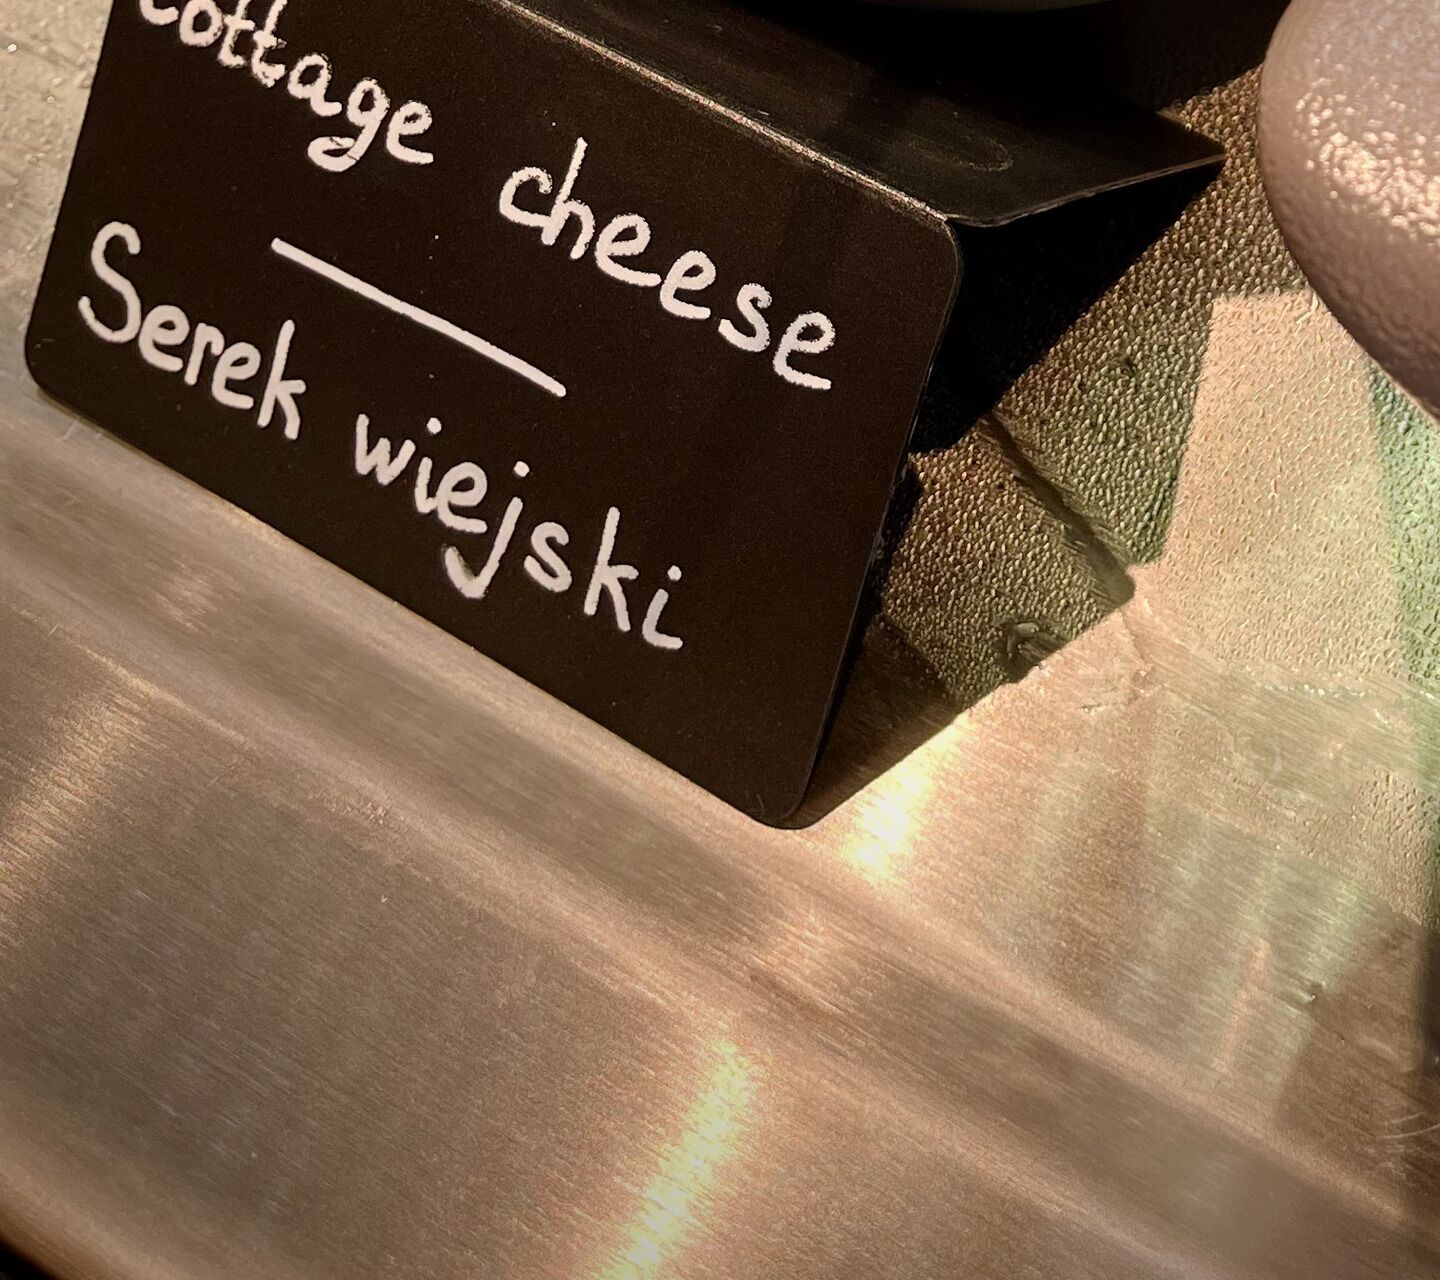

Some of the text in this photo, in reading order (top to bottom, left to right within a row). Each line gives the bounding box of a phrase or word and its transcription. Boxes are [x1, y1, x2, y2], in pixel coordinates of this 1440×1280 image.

[498, 137, 833, 390] cheese
[78, 222, 684, 650] Serek wiejski
